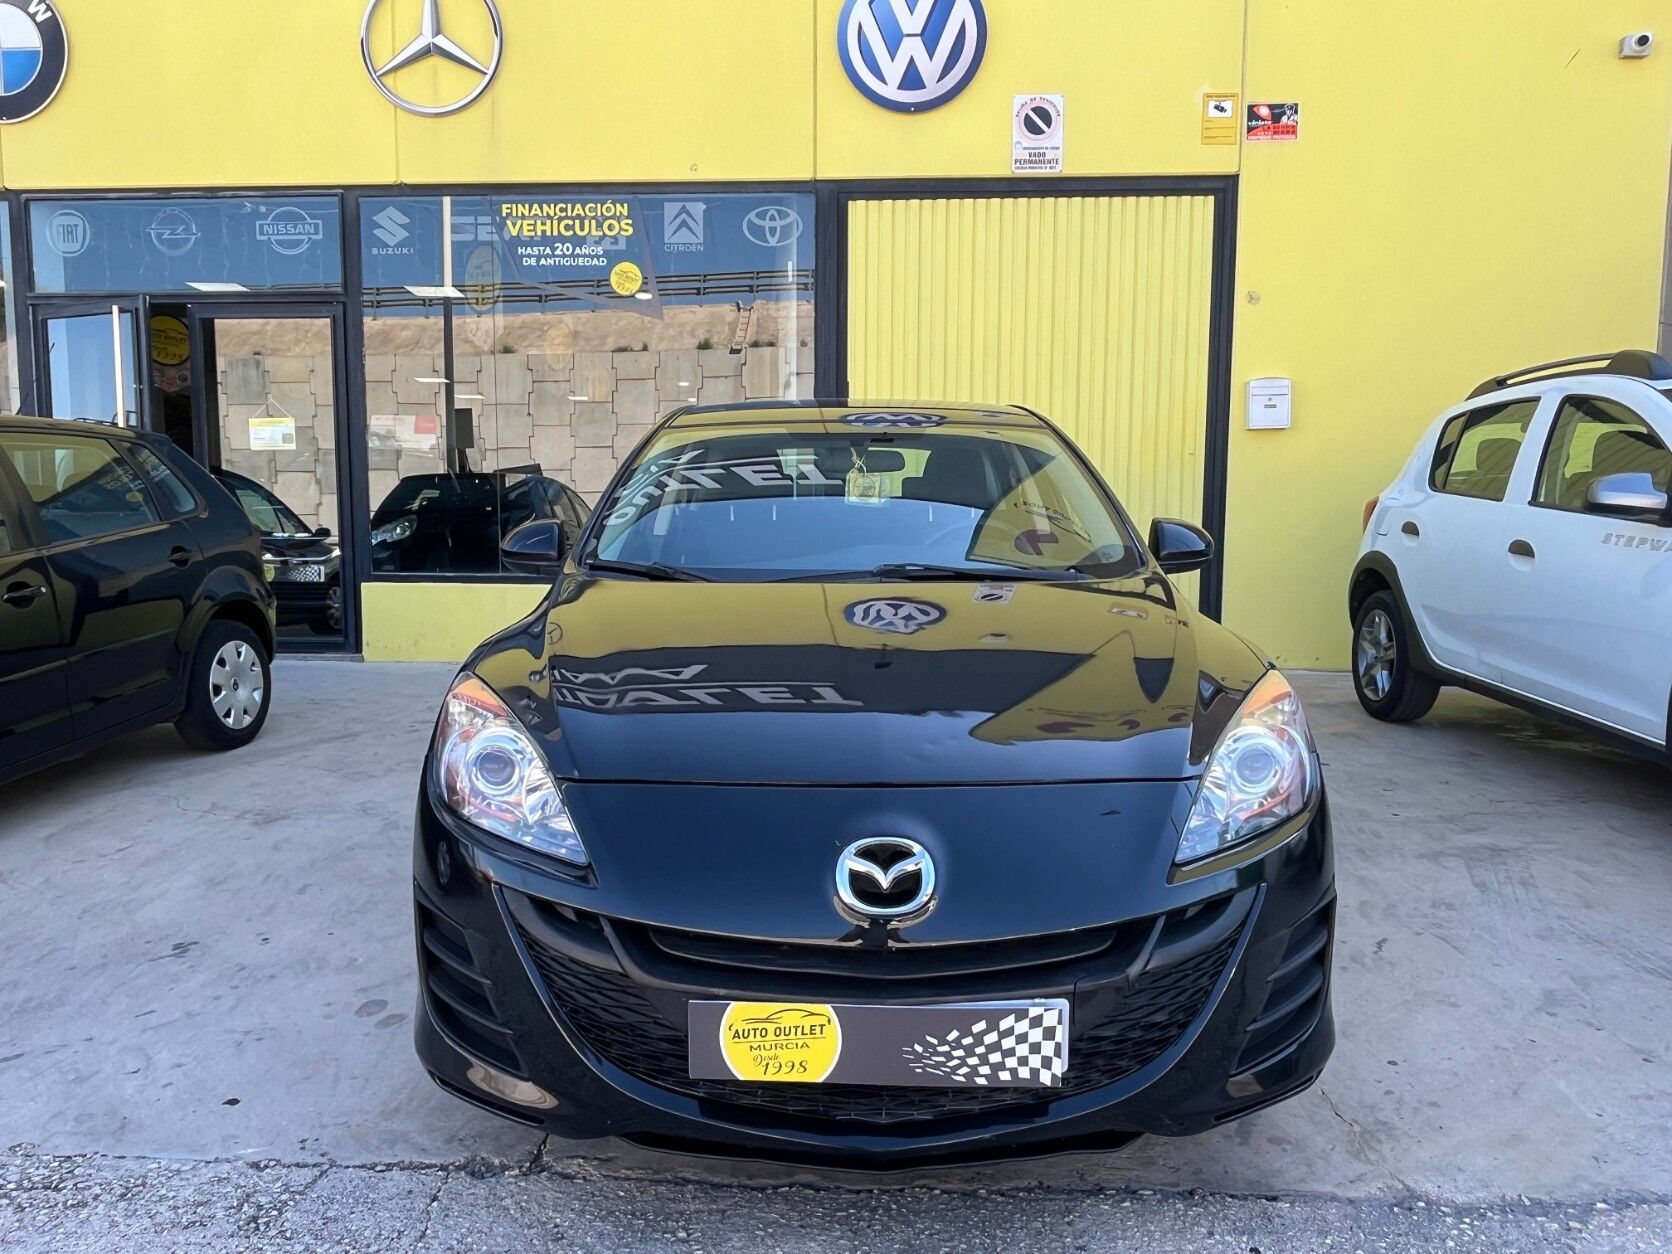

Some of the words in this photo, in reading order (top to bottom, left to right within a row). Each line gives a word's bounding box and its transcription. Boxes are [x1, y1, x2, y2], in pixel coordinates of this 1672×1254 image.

[1014, 158, 1060, 166] PERMANENTE
[501, 200, 629, 217] FINANCIACIÓN
[56, 223, 80, 244] FIAT
[263, 223, 315, 235] NISSAN
[505, 216, 634, 237] VEHÍCULOS
[371, 247, 415, 255] SUZUKI
[517, 246, 552, 256] HASTA
[553, 242, 574, 256] 20
[574, 245, 604, 256] AÑOS
[522, 257, 538, 266] DE
[732, 1027, 768, 1040] AUTO
[773, 1023, 827, 1038] OUTLET
[749, 1041, 810, 1053] MURCIA
[762, 1059, 809, 1076] 1998
